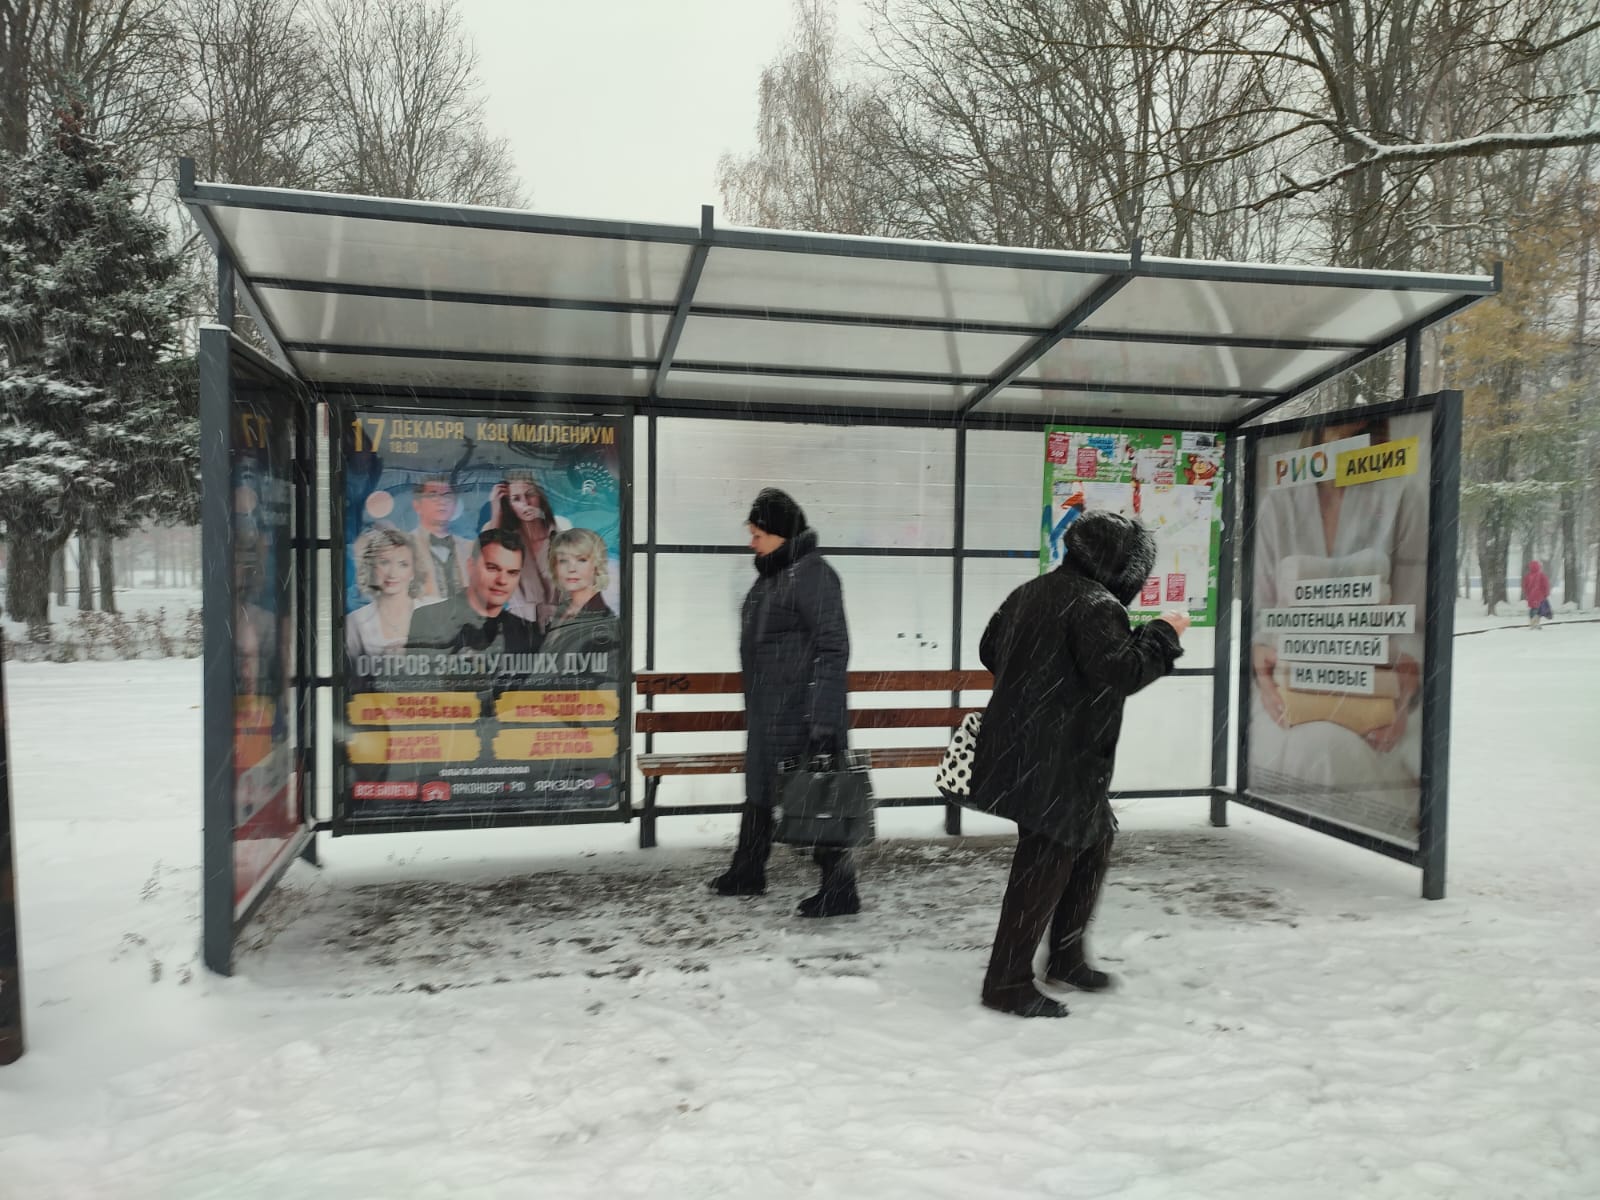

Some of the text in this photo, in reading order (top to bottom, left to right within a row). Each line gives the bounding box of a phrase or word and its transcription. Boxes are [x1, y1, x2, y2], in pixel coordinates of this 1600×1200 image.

[351, 418, 464, 452] 17 ДЕКАБРЯ
[477, 422, 614, 445] КЗЦ МИЛЛЕНИУМ
[1275, 450, 1328, 486] РИО
[1295, 582, 1373, 601] ОБМЕНЯЕМ
[1267, 609, 1406, 629] ПОЛОТЕНЦА НАШИХ
[1284, 637, 1382, 657] ПОКУПАТЕЛЕЙ
[357, 652, 608, 677] ОСТРОВ ЗАБЛУДШИХ ДУШ
[1295, 667, 1368, 688] НА НОВЫЕ
[362, 706, 471, 720] ПРОКОФЬЕВА
[377, 784, 417, 796] БИЛЕТЫ
